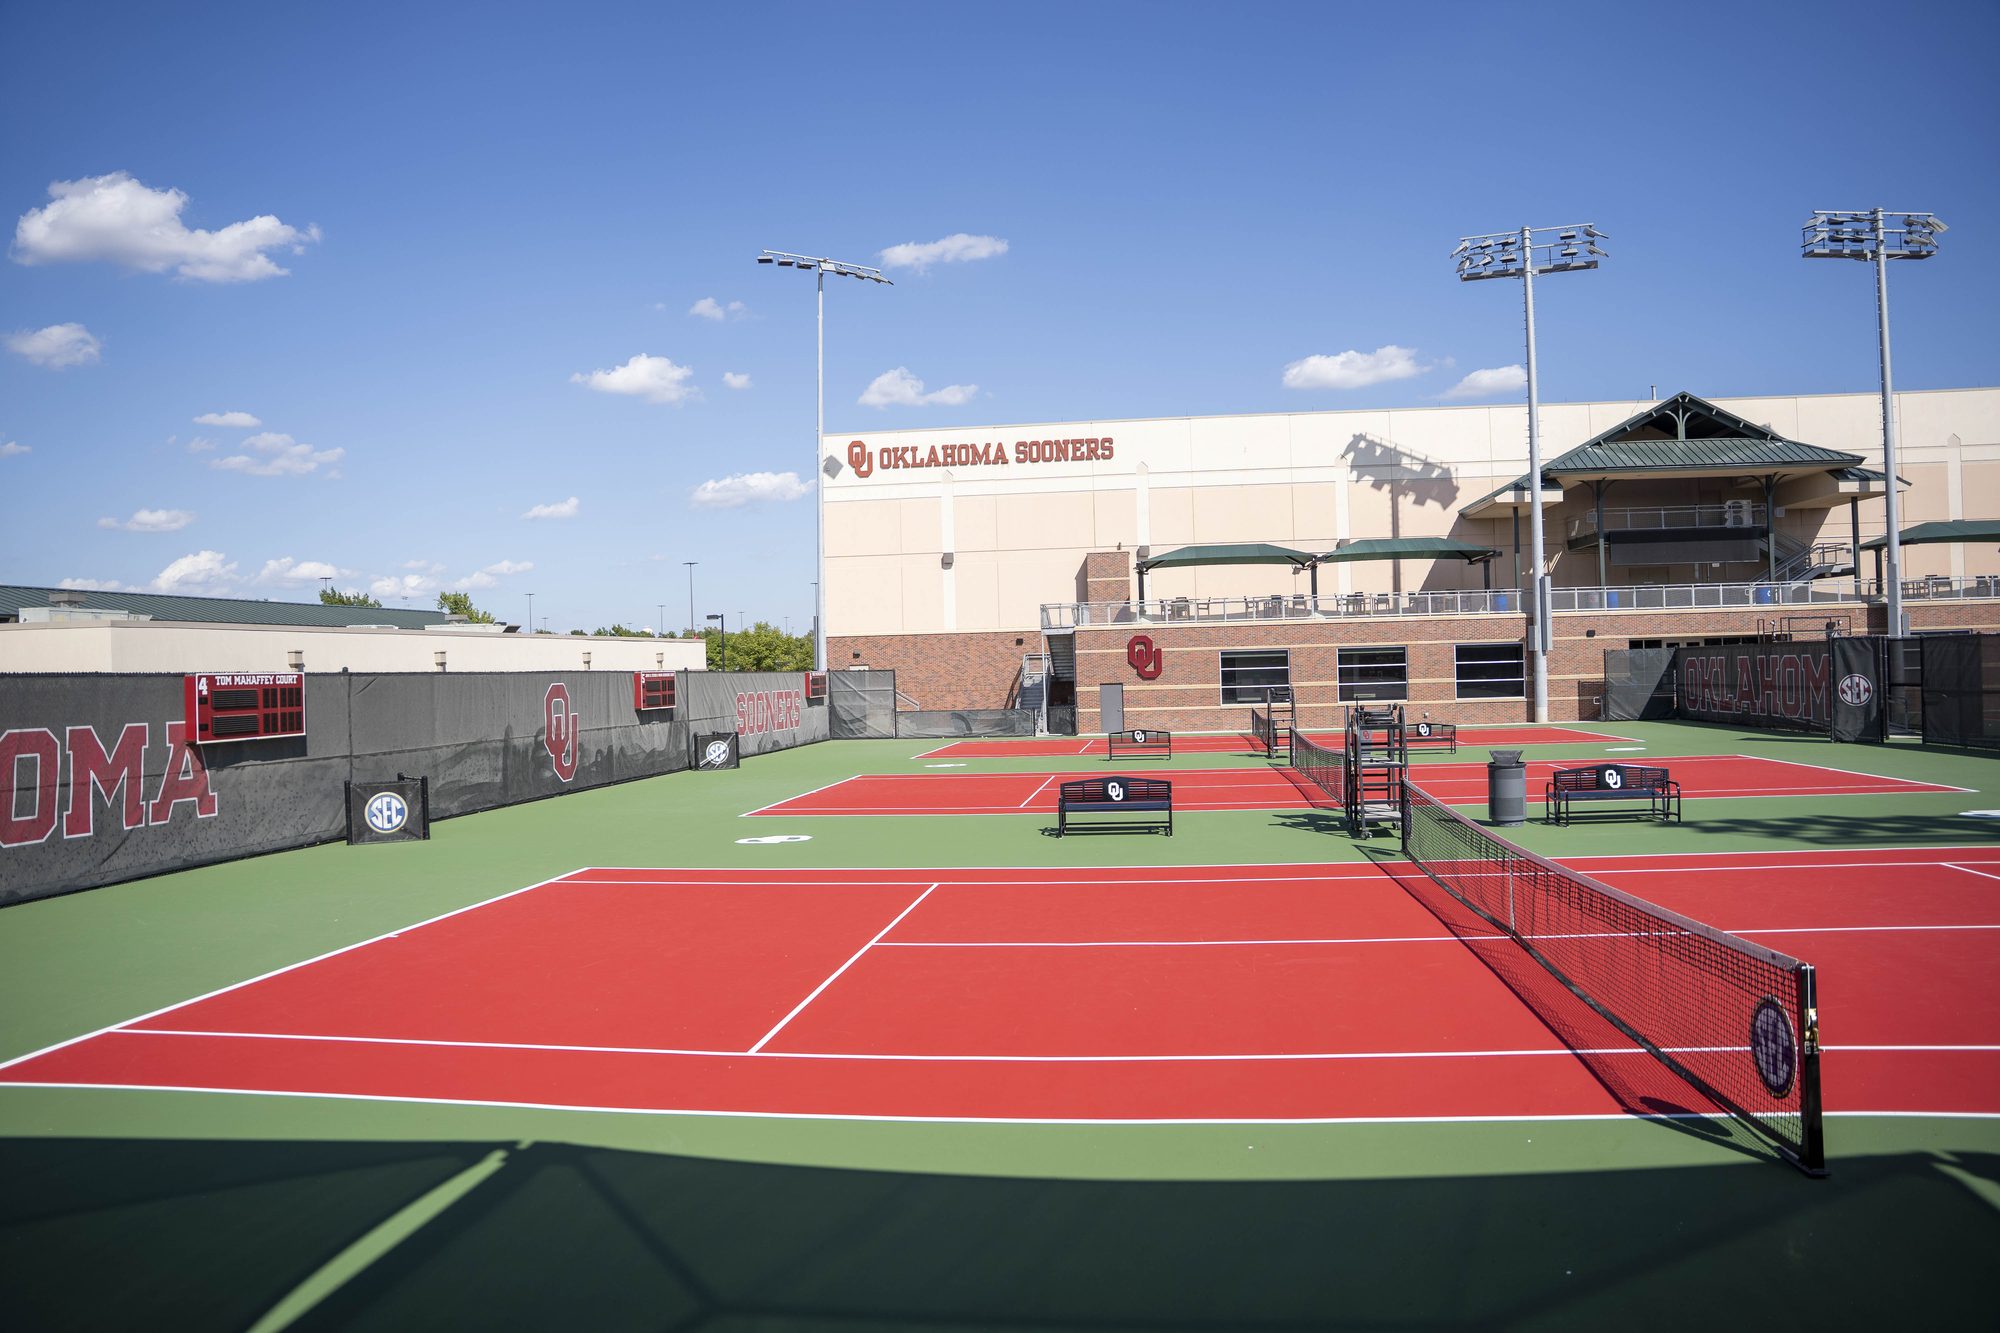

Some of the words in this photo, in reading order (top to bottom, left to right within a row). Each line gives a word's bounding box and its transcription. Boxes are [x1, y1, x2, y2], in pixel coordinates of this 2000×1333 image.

[847, 440, 873, 478] OU
[879, 442, 1009, 470] OKLAHOMA
[1015, 437, 1114, 463] SOONERS
[1127, 635, 1162, 680] OU
[198, 677, 208, 695] 4
[215, 676, 232, 686] TOM
[234, 675, 274, 686] MAHAFFEY
[275, 675, 298, 685] COURT
[1841, 676, 1870, 704] SEC
[736, 689, 801, 737] SOONERS
[544, 682, 578, 783] OU
[1107, 782, 1124, 801] OU
[1605, 769, 1621, 789] OU
[370, 796, 404, 829] SEC
